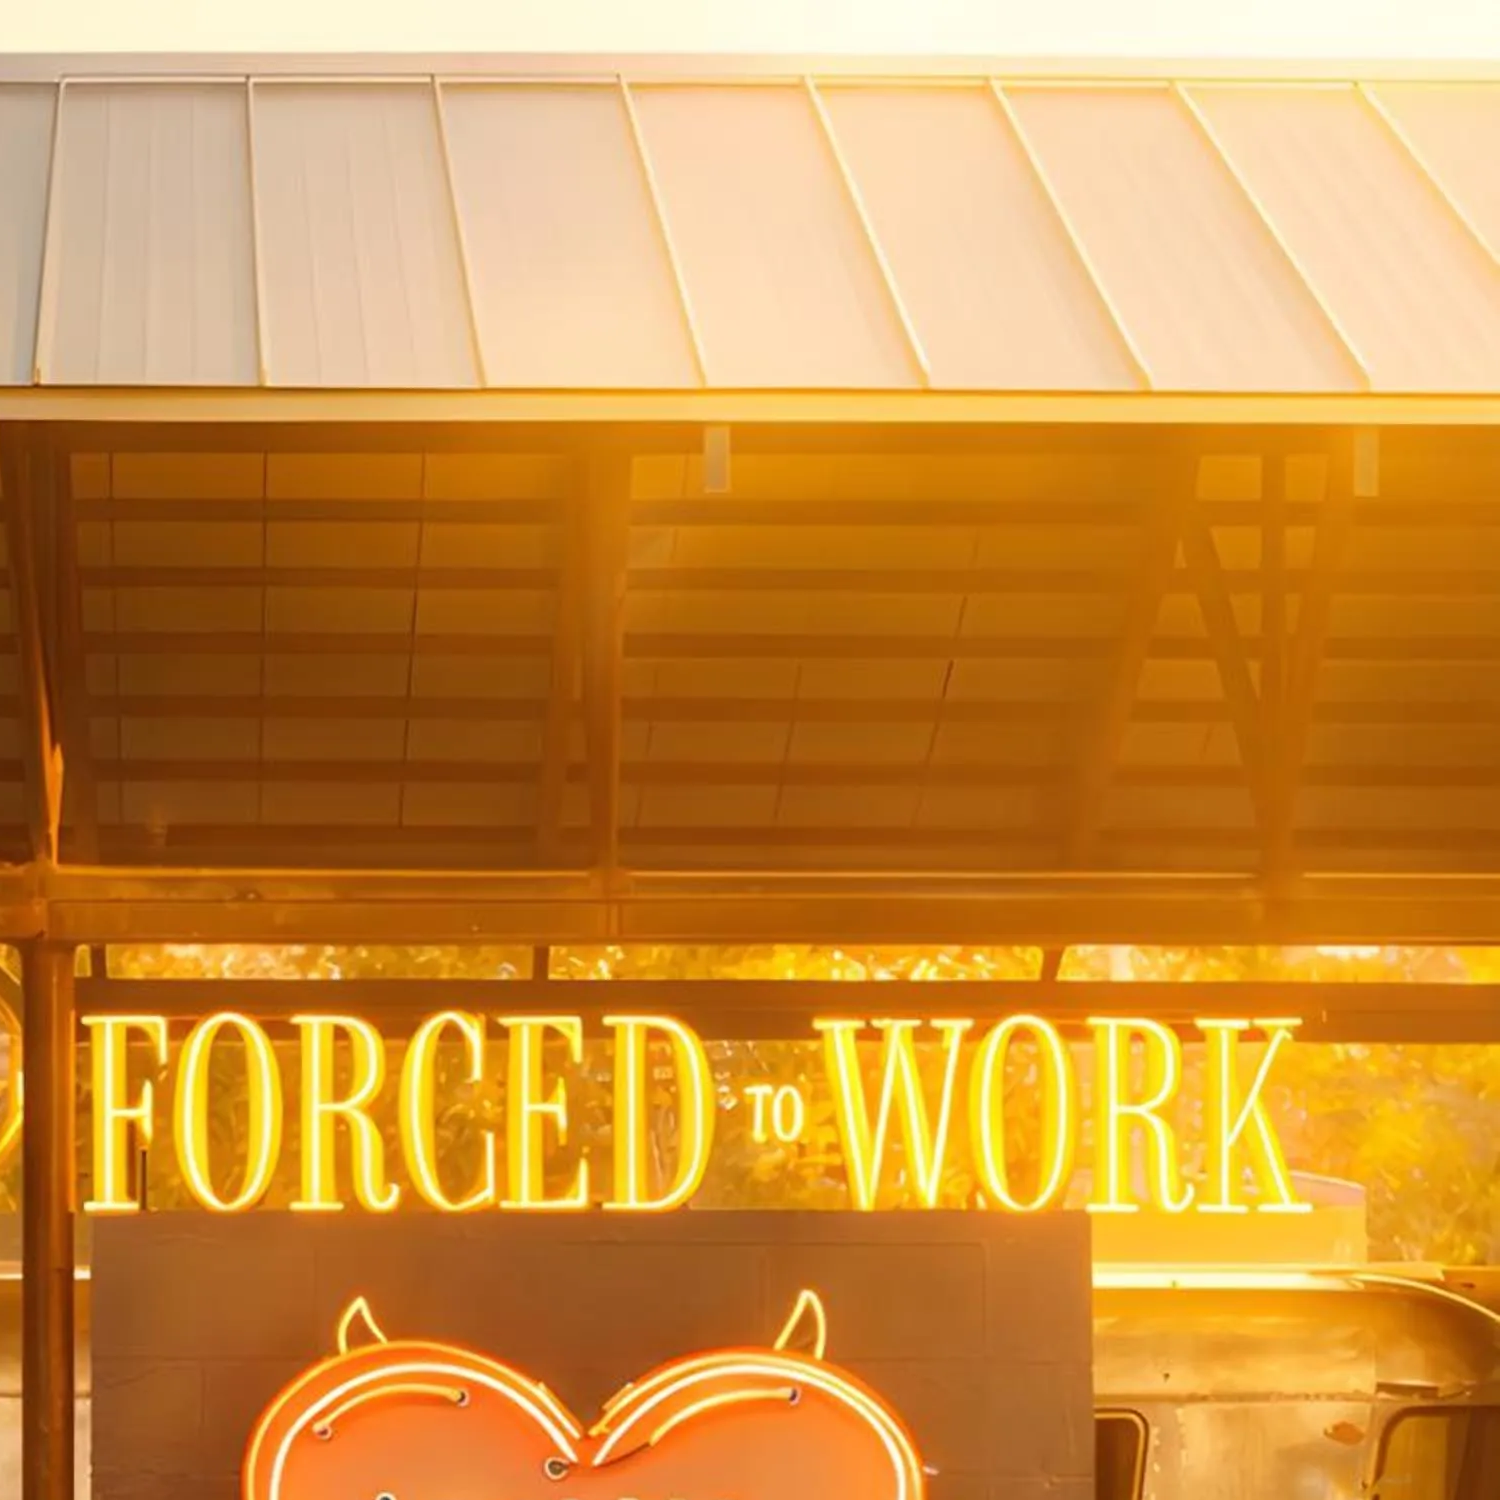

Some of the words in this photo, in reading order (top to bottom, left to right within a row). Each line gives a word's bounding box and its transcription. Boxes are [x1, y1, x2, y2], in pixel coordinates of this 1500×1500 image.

[81, 1012, 715, 1212] FORCED
[745, 1084, 803, 1143] TO
[813, 1014, 1312, 1213] WORK
